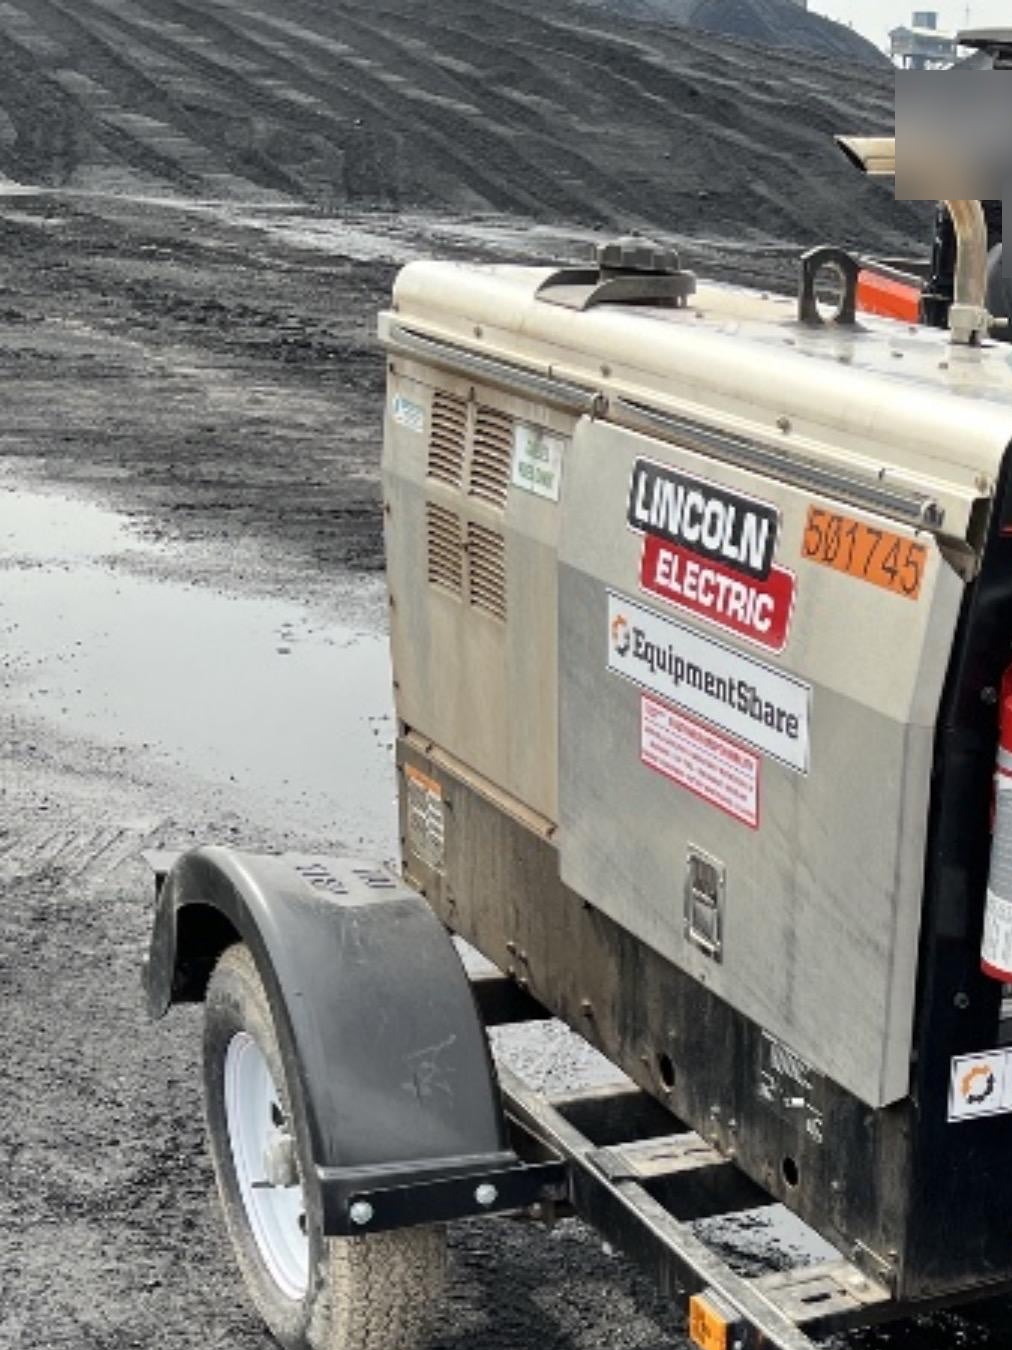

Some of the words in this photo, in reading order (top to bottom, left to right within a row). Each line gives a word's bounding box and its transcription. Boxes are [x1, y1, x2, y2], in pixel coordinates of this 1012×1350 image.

[633, 470, 769, 571] LINCOLN
[803, 508, 927, 595] 501745
[655, 549, 775, 633] ELECTRIC
[632, 626, 800, 740] EquipmentShare
